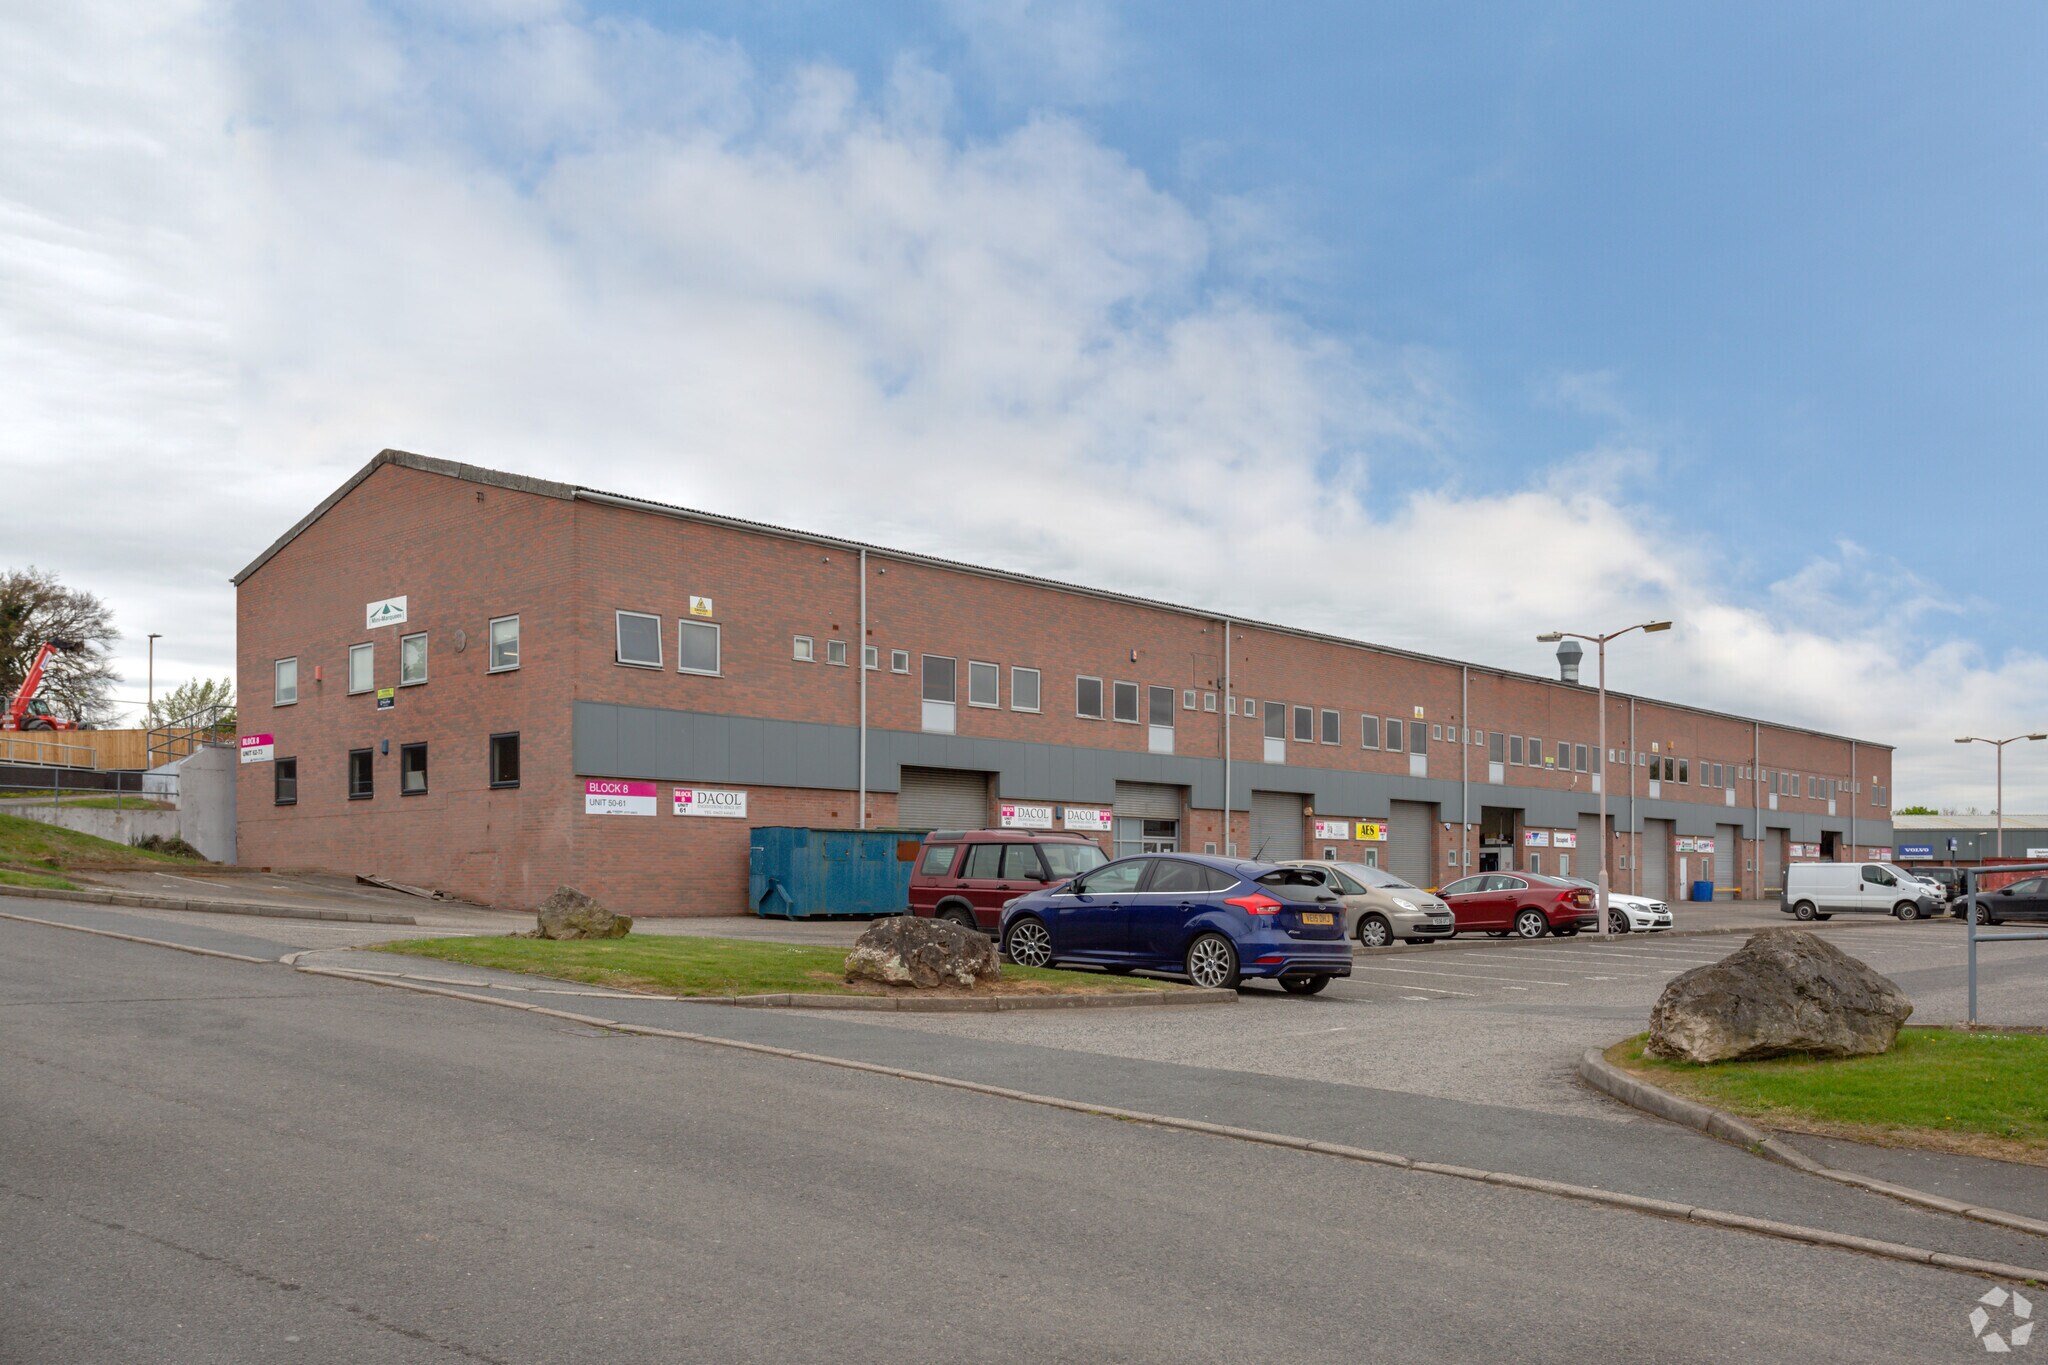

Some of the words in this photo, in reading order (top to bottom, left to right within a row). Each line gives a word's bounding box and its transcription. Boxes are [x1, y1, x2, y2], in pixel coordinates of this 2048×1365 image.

[242, 737, 256, 746] BLOCK
[590, 782, 621, 793] BLOCK
[623, 784, 629, 793] 8
[590, 798, 606, 806] UNIT
[608, 799, 626, 807] 50-61
[697, 792, 742, 806] DACOL
[1017, 807, 1050, 819] DACOL
[1067, 810, 1097, 821] DACOL
[1361, 824, 1375, 836] AES
